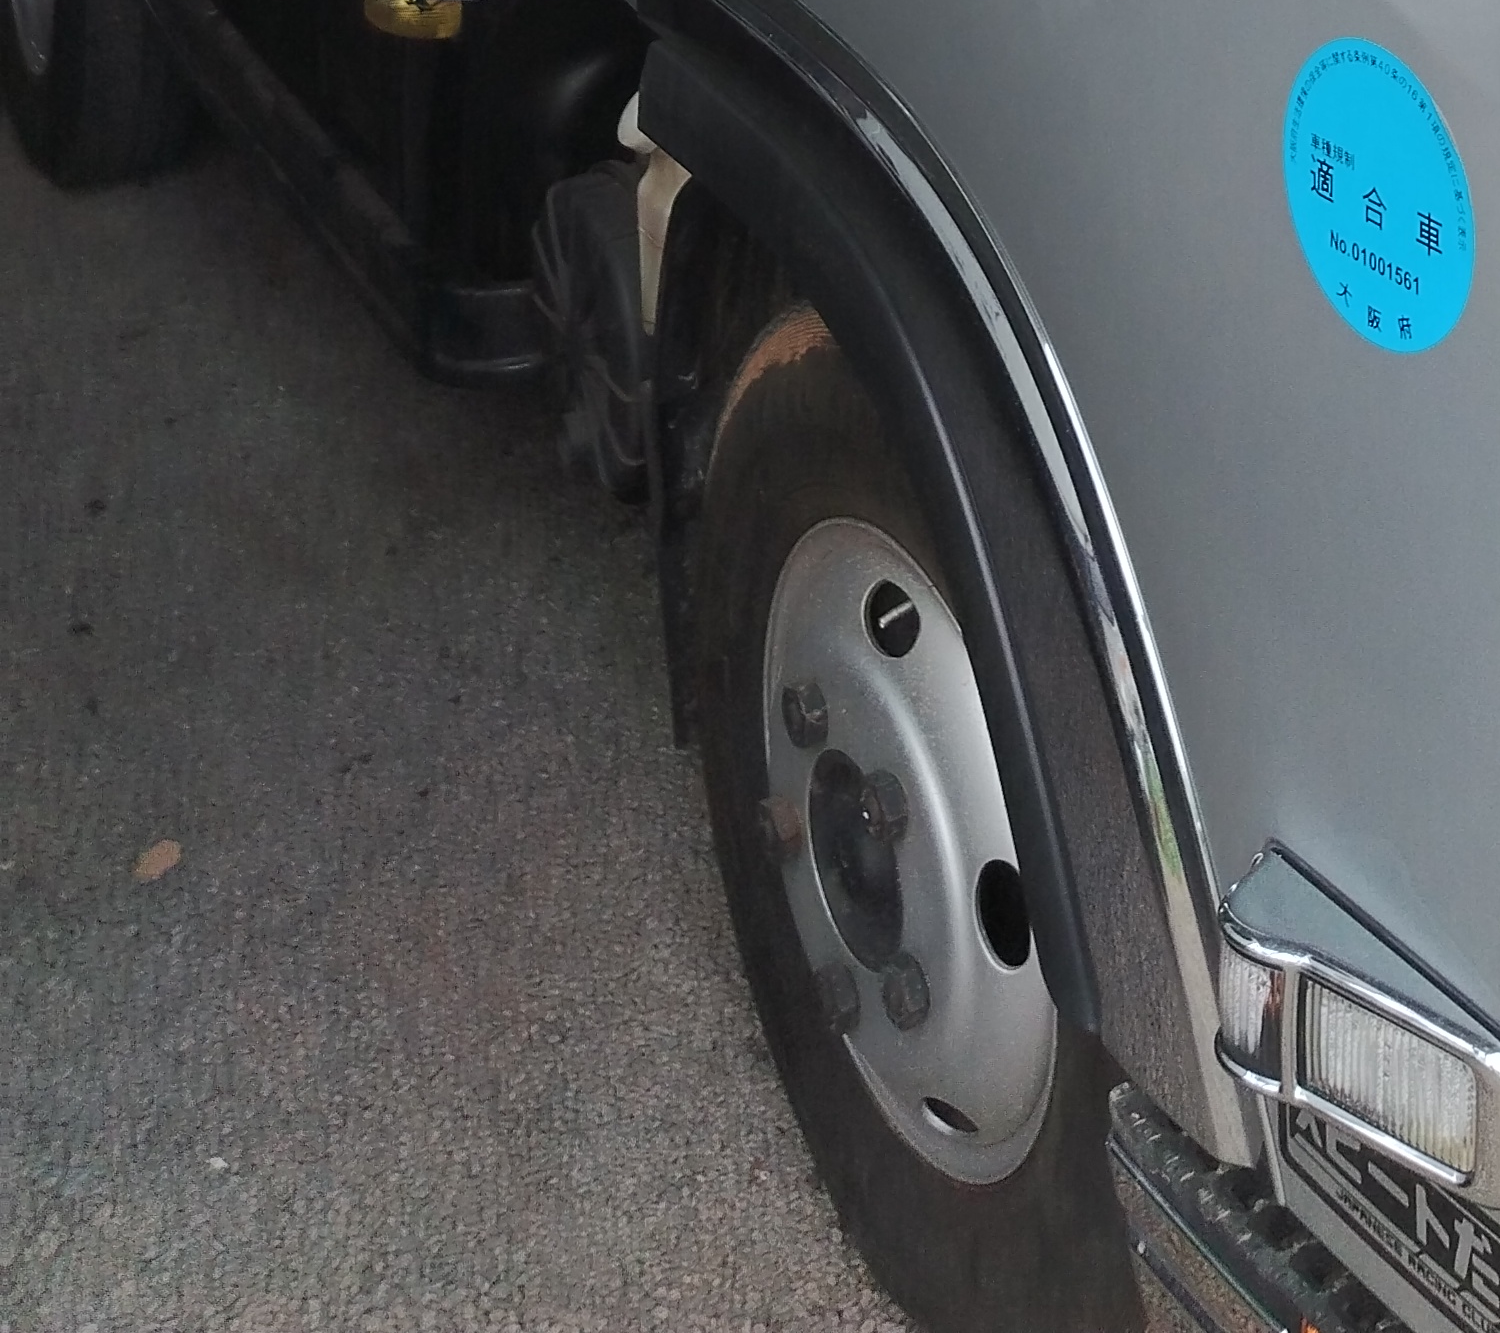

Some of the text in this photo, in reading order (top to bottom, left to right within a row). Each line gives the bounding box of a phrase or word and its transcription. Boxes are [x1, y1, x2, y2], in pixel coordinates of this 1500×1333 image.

[1309, 153, 1443, 257] 適合車
[1329, 229, 1420, 296] No.01001561
[1407, 1256, 1458, 1307] RACING
